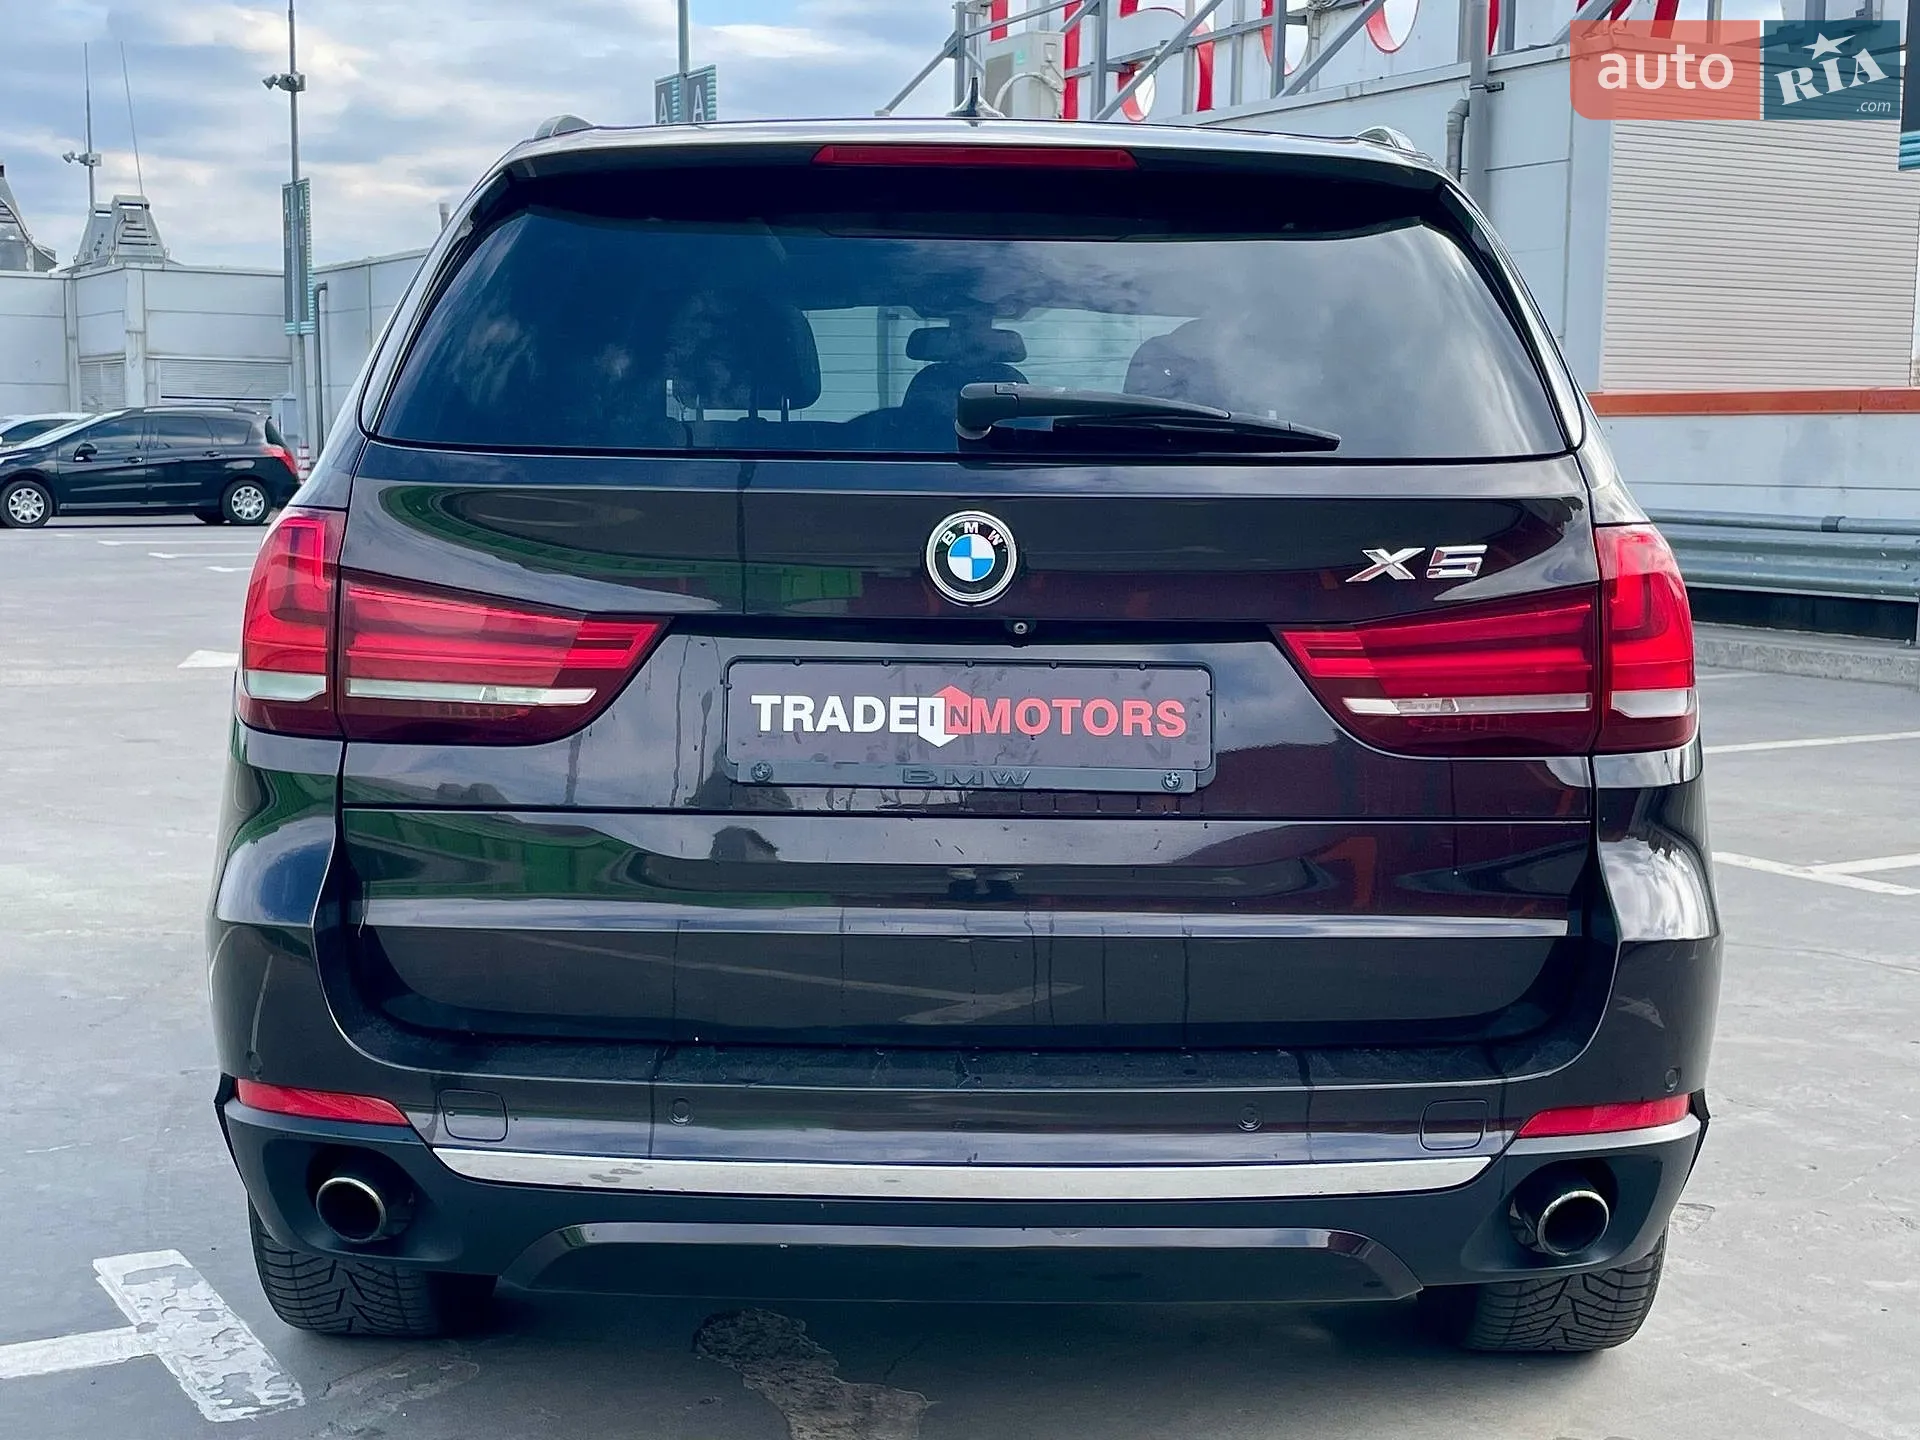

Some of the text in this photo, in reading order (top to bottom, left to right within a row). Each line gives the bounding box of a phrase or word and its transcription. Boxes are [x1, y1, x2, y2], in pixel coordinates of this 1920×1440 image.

[692, 84, 705, 123] A
[941, 521, 1004, 546] BMW
[1345, 544, 1488, 583] X5
[901, 766, 1032, 788] BMW
